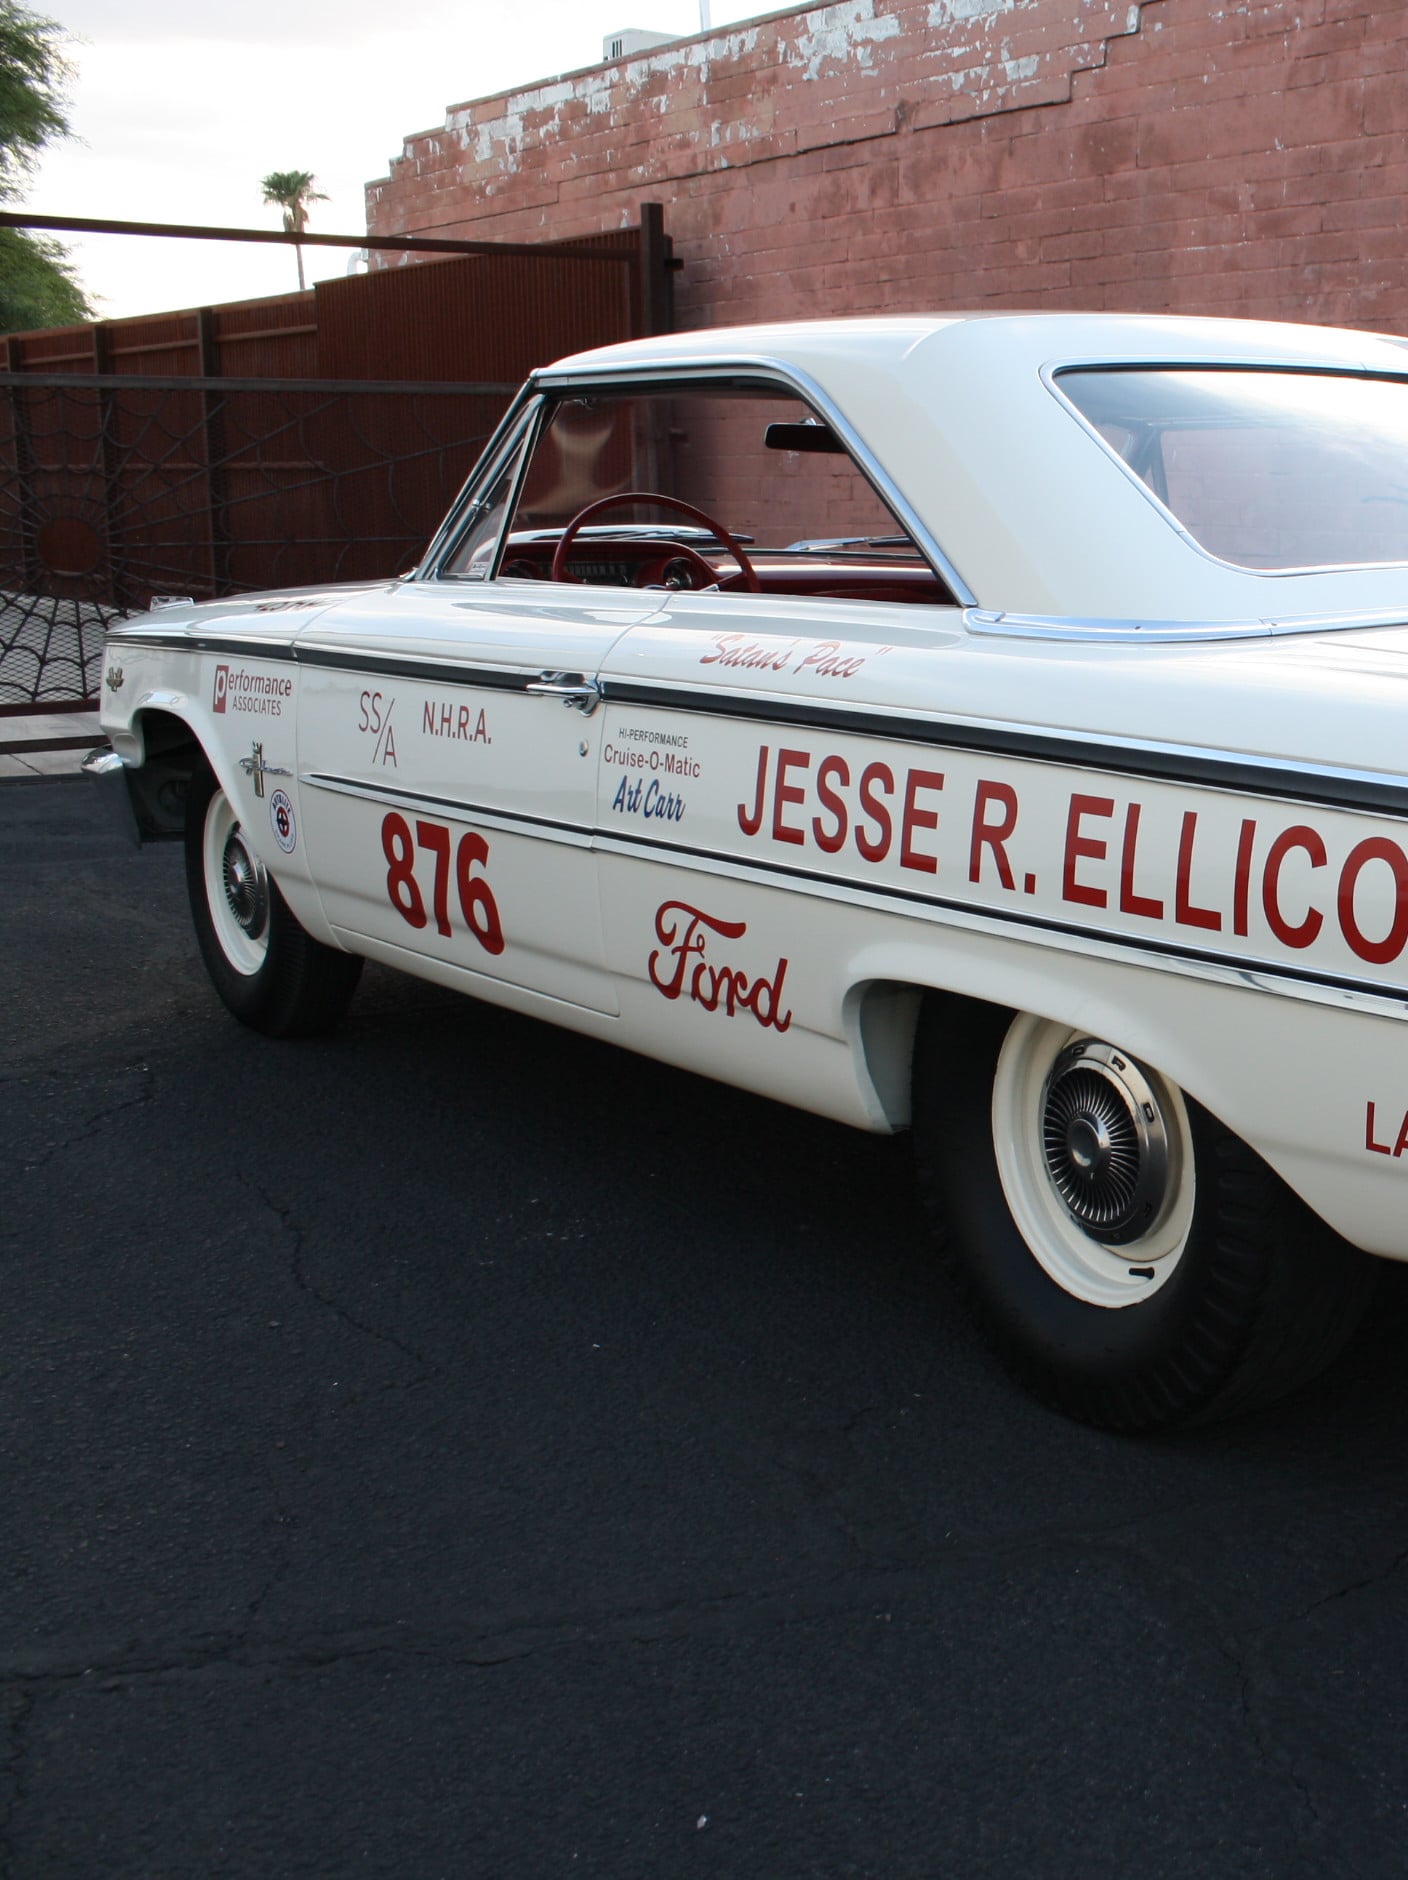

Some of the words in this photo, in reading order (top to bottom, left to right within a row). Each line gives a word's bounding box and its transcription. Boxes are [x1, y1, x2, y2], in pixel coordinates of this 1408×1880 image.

[232, 695, 282, 716] ASSOCIATES
[422, 700, 492, 745] N.H.R.A.
[603, 744, 701, 778] Cruise-O-Matic
[619, 728, 689, 749] HI-PERFORMANCE
[612, 775, 643, 813] Art
[643, 778, 687, 822] Carr
[737, 745, 945, 874] JESSE
[968, 779, 1036, 895] R.
[381, 812, 505, 955] 876
[648, 900, 792, 1033] Ford
